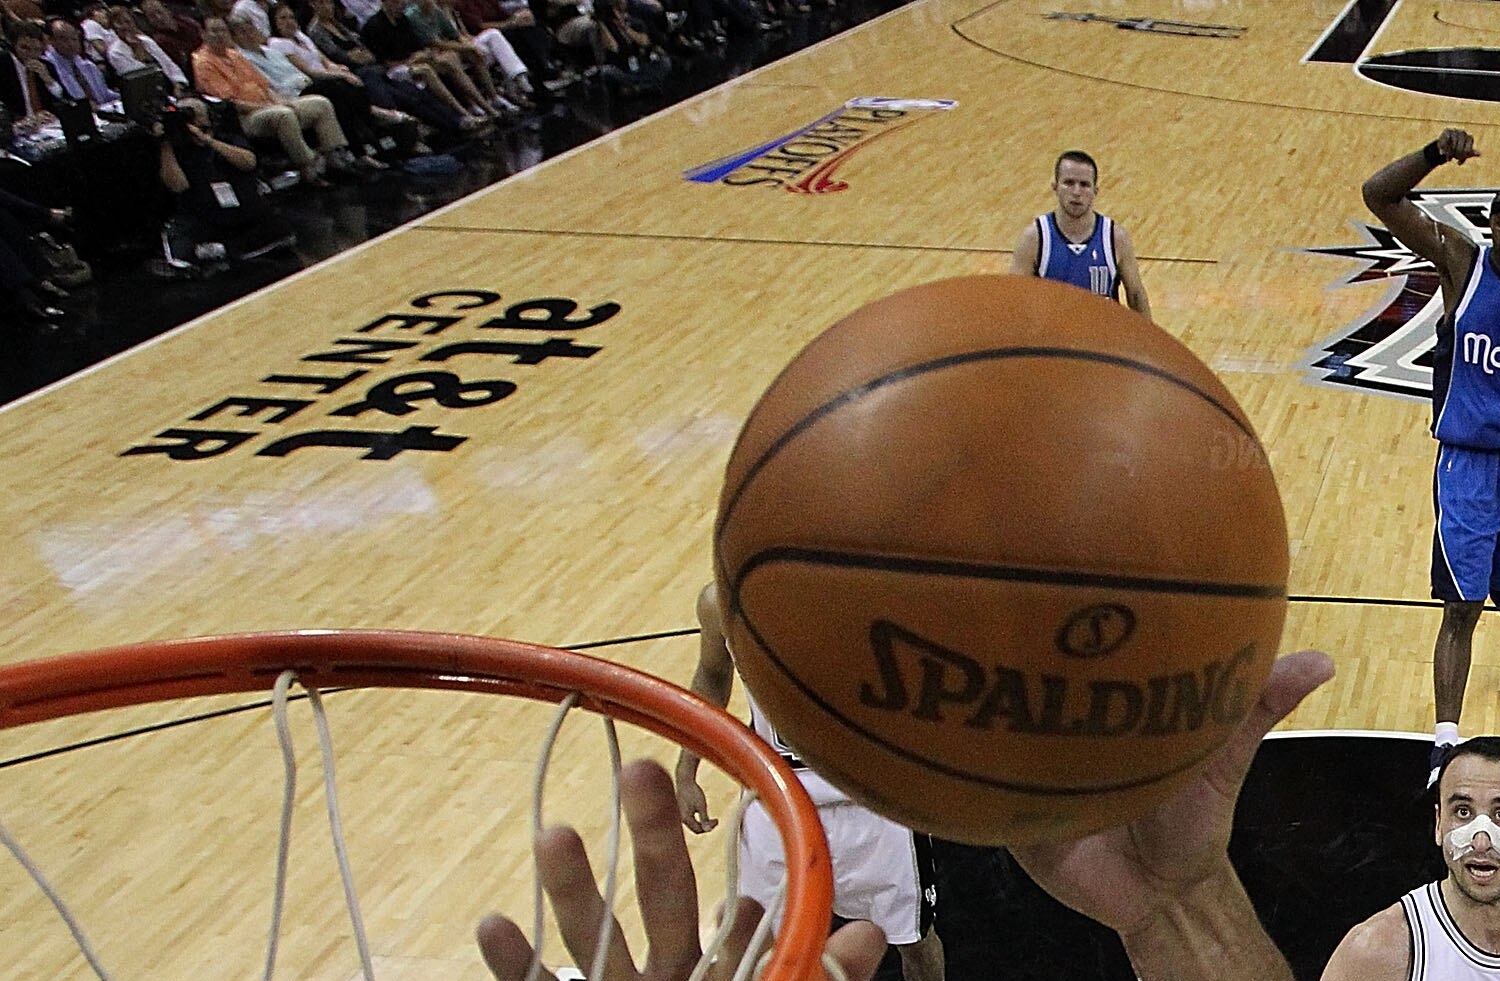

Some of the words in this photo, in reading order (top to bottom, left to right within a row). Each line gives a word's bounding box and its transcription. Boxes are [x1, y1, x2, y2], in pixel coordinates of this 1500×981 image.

[722, 106, 907, 186] PLAYOFFS
[118, 289, 502, 462] CENTER
[256, 298, 622, 461] at&t
[858, 617, 1257, 738] SPALDING
